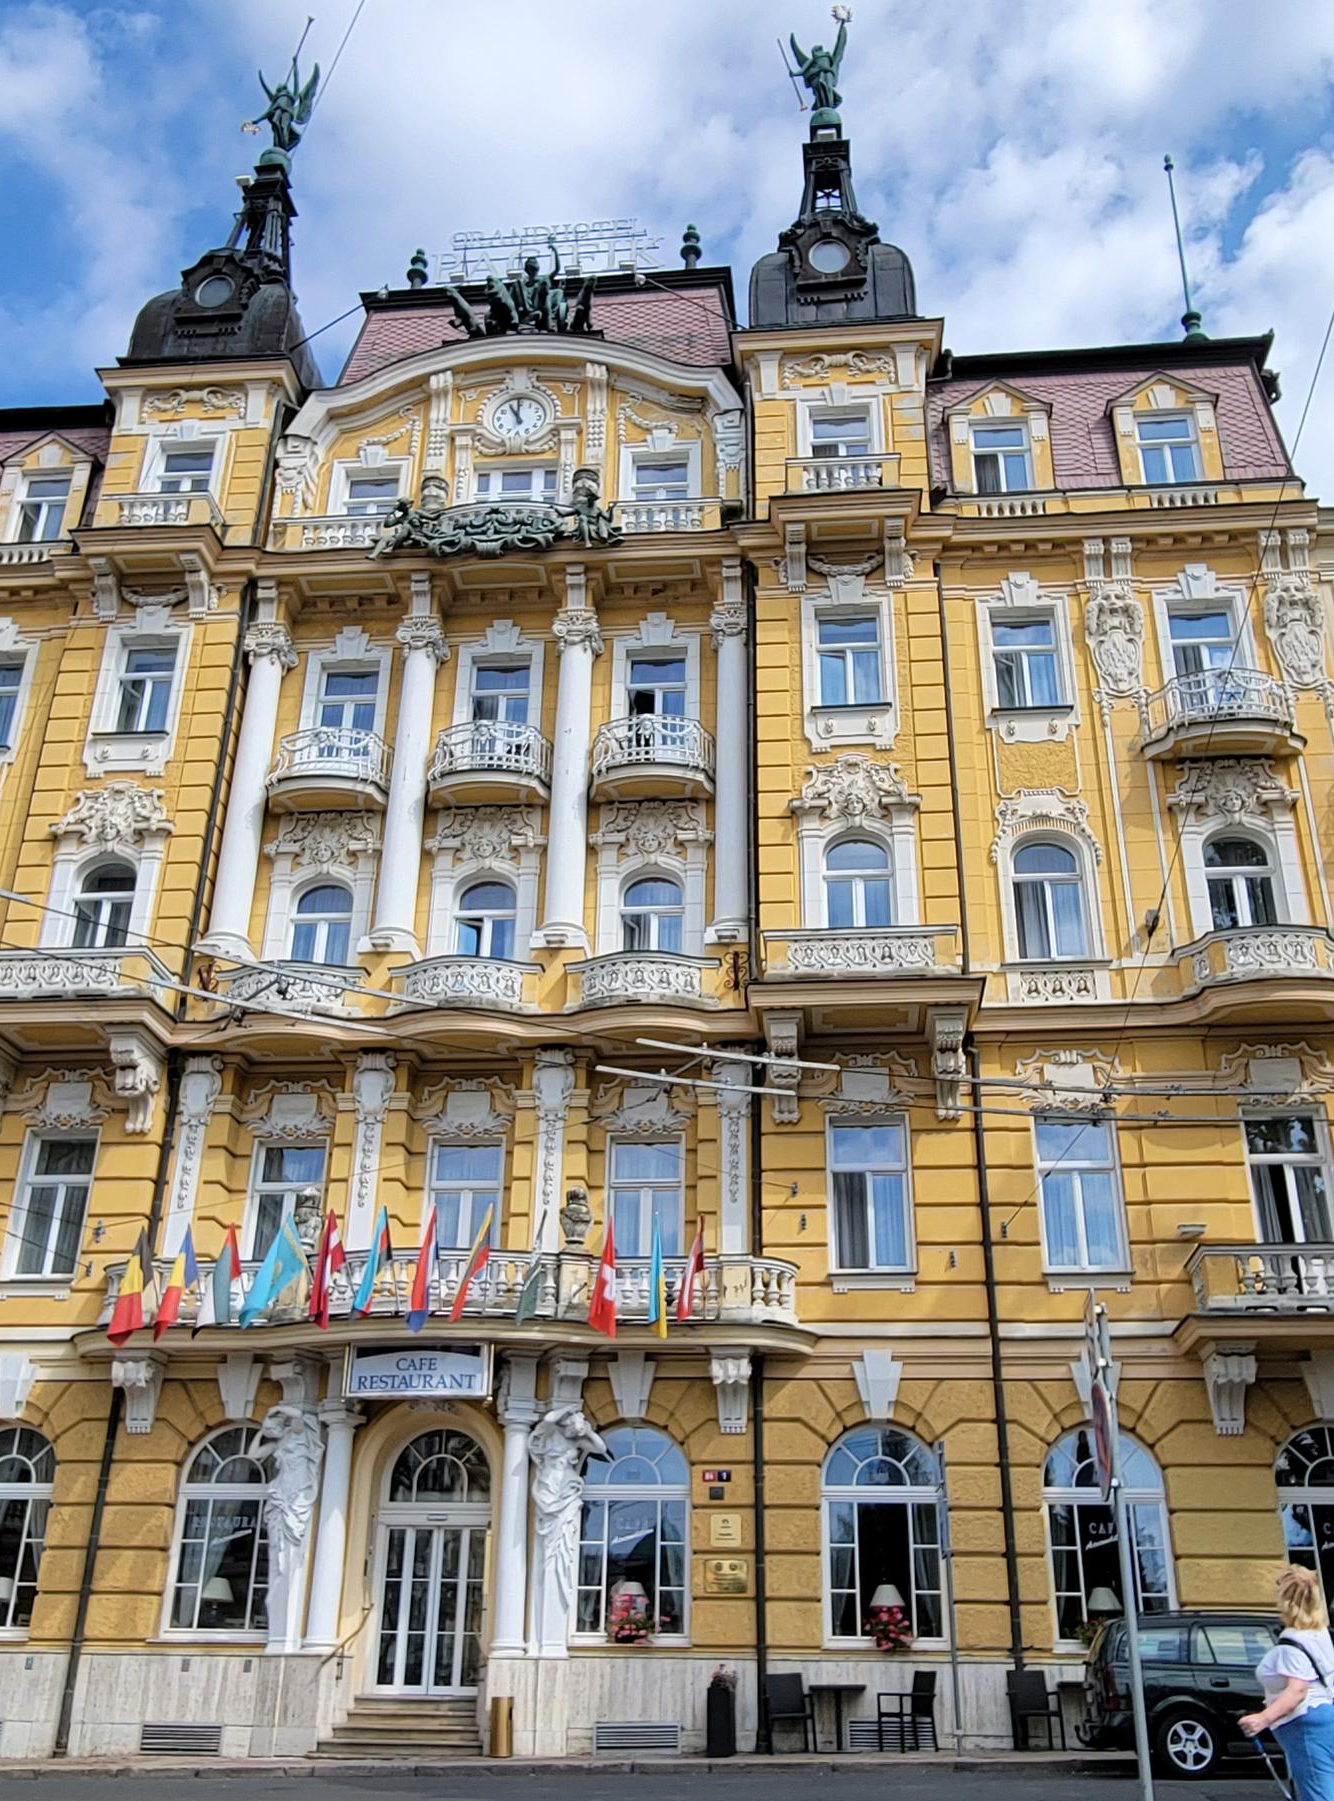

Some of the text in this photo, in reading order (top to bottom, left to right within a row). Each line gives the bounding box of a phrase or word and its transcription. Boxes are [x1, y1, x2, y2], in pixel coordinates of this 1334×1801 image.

[452, 218, 648, 249] GRANDHOTEL
[432, 237, 665, 283] PACFIK
[395, 1357, 438, 1372] CAFE
[357, 1374, 477, 1391] RESTAURANT
[1088, 1522, 1115, 1534] CAF
